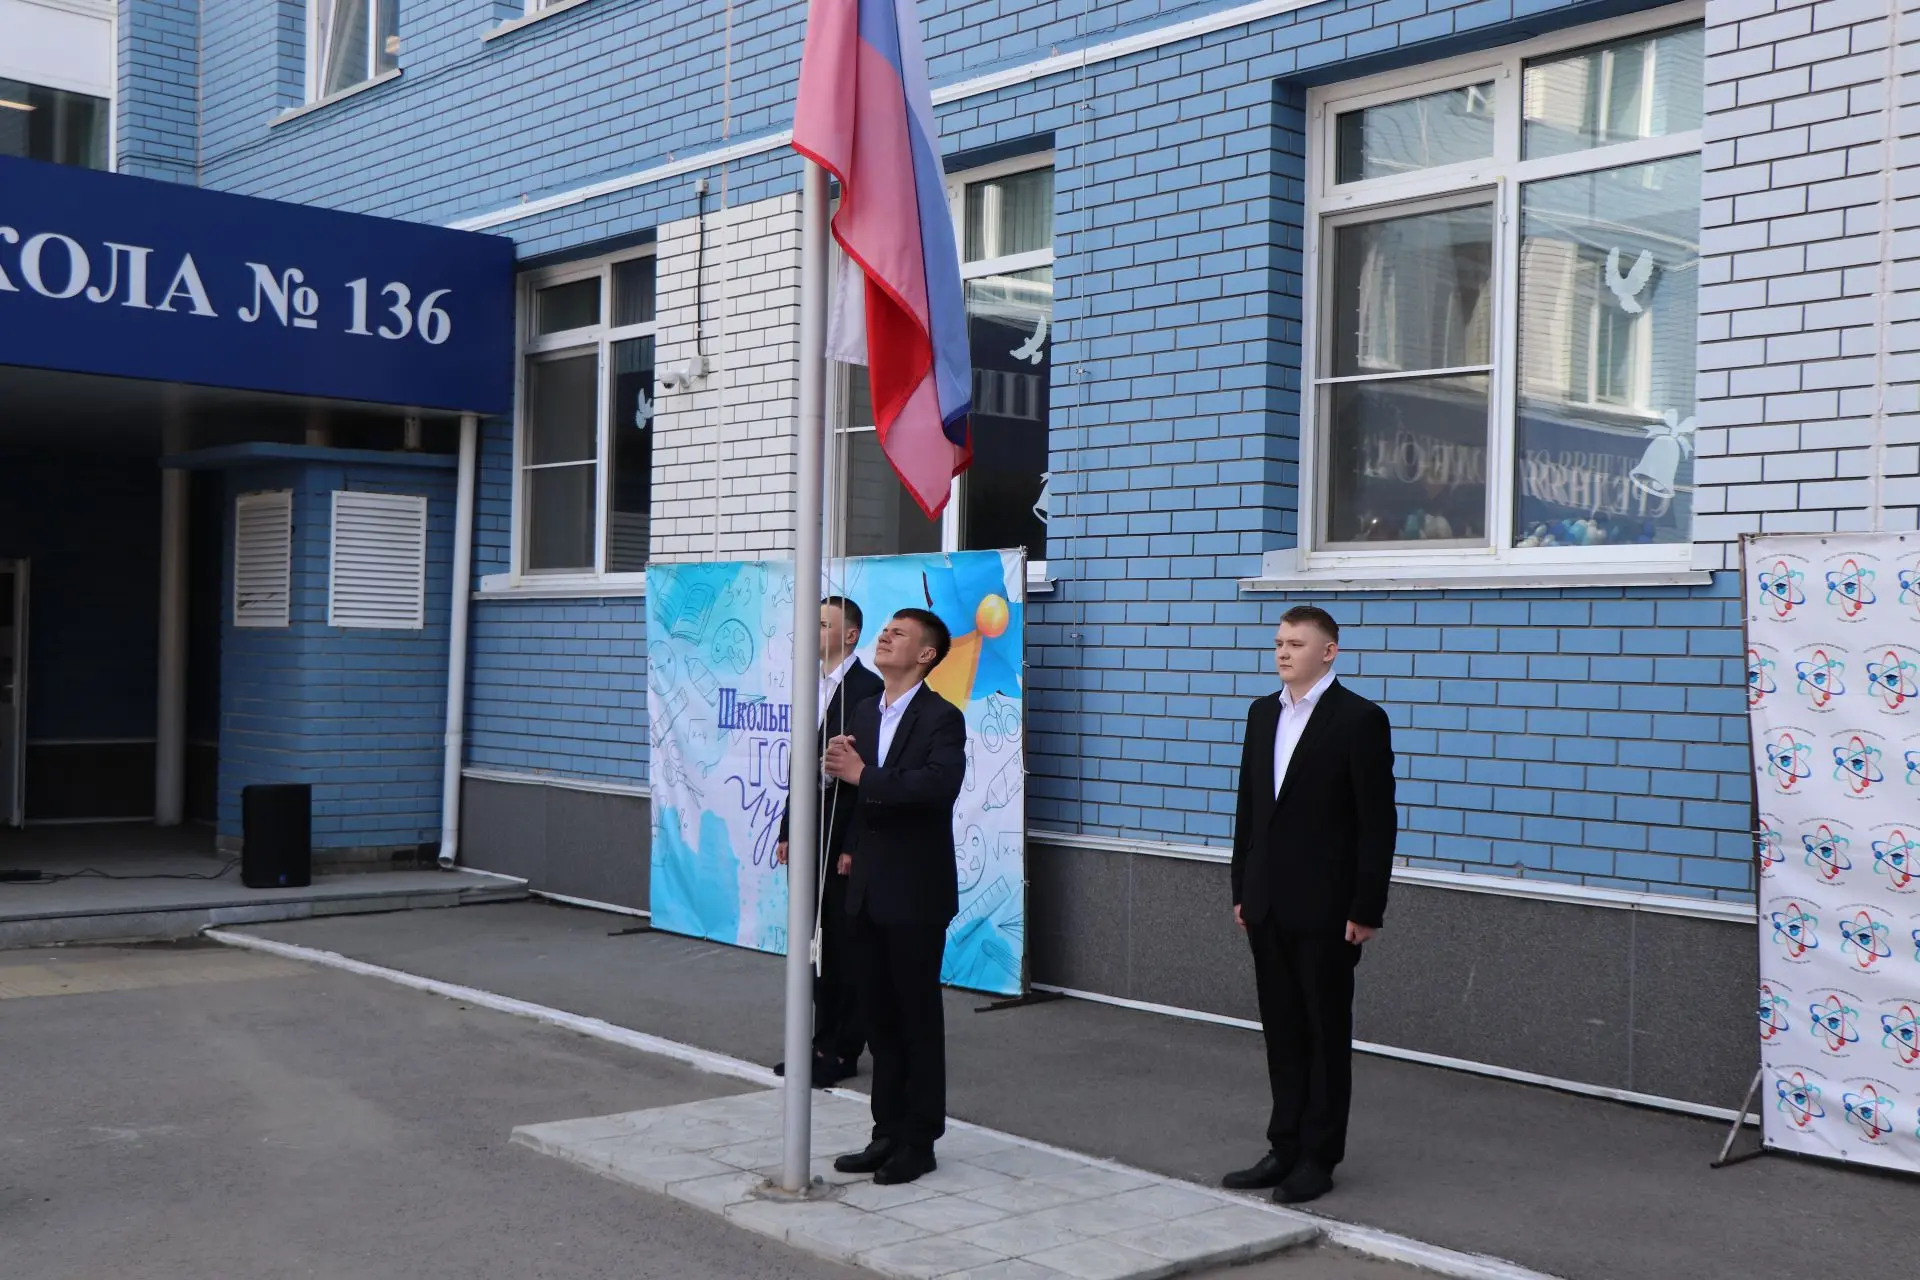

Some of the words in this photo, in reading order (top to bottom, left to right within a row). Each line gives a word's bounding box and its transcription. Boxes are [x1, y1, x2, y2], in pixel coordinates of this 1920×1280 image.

[238, 262, 319, 330] №
[344, 277, 452, 345] 136
[718, 688, 792, 732] Школьн
[750, 737, 791, 790] ГО
[724, 775, 787, 870] Чу
